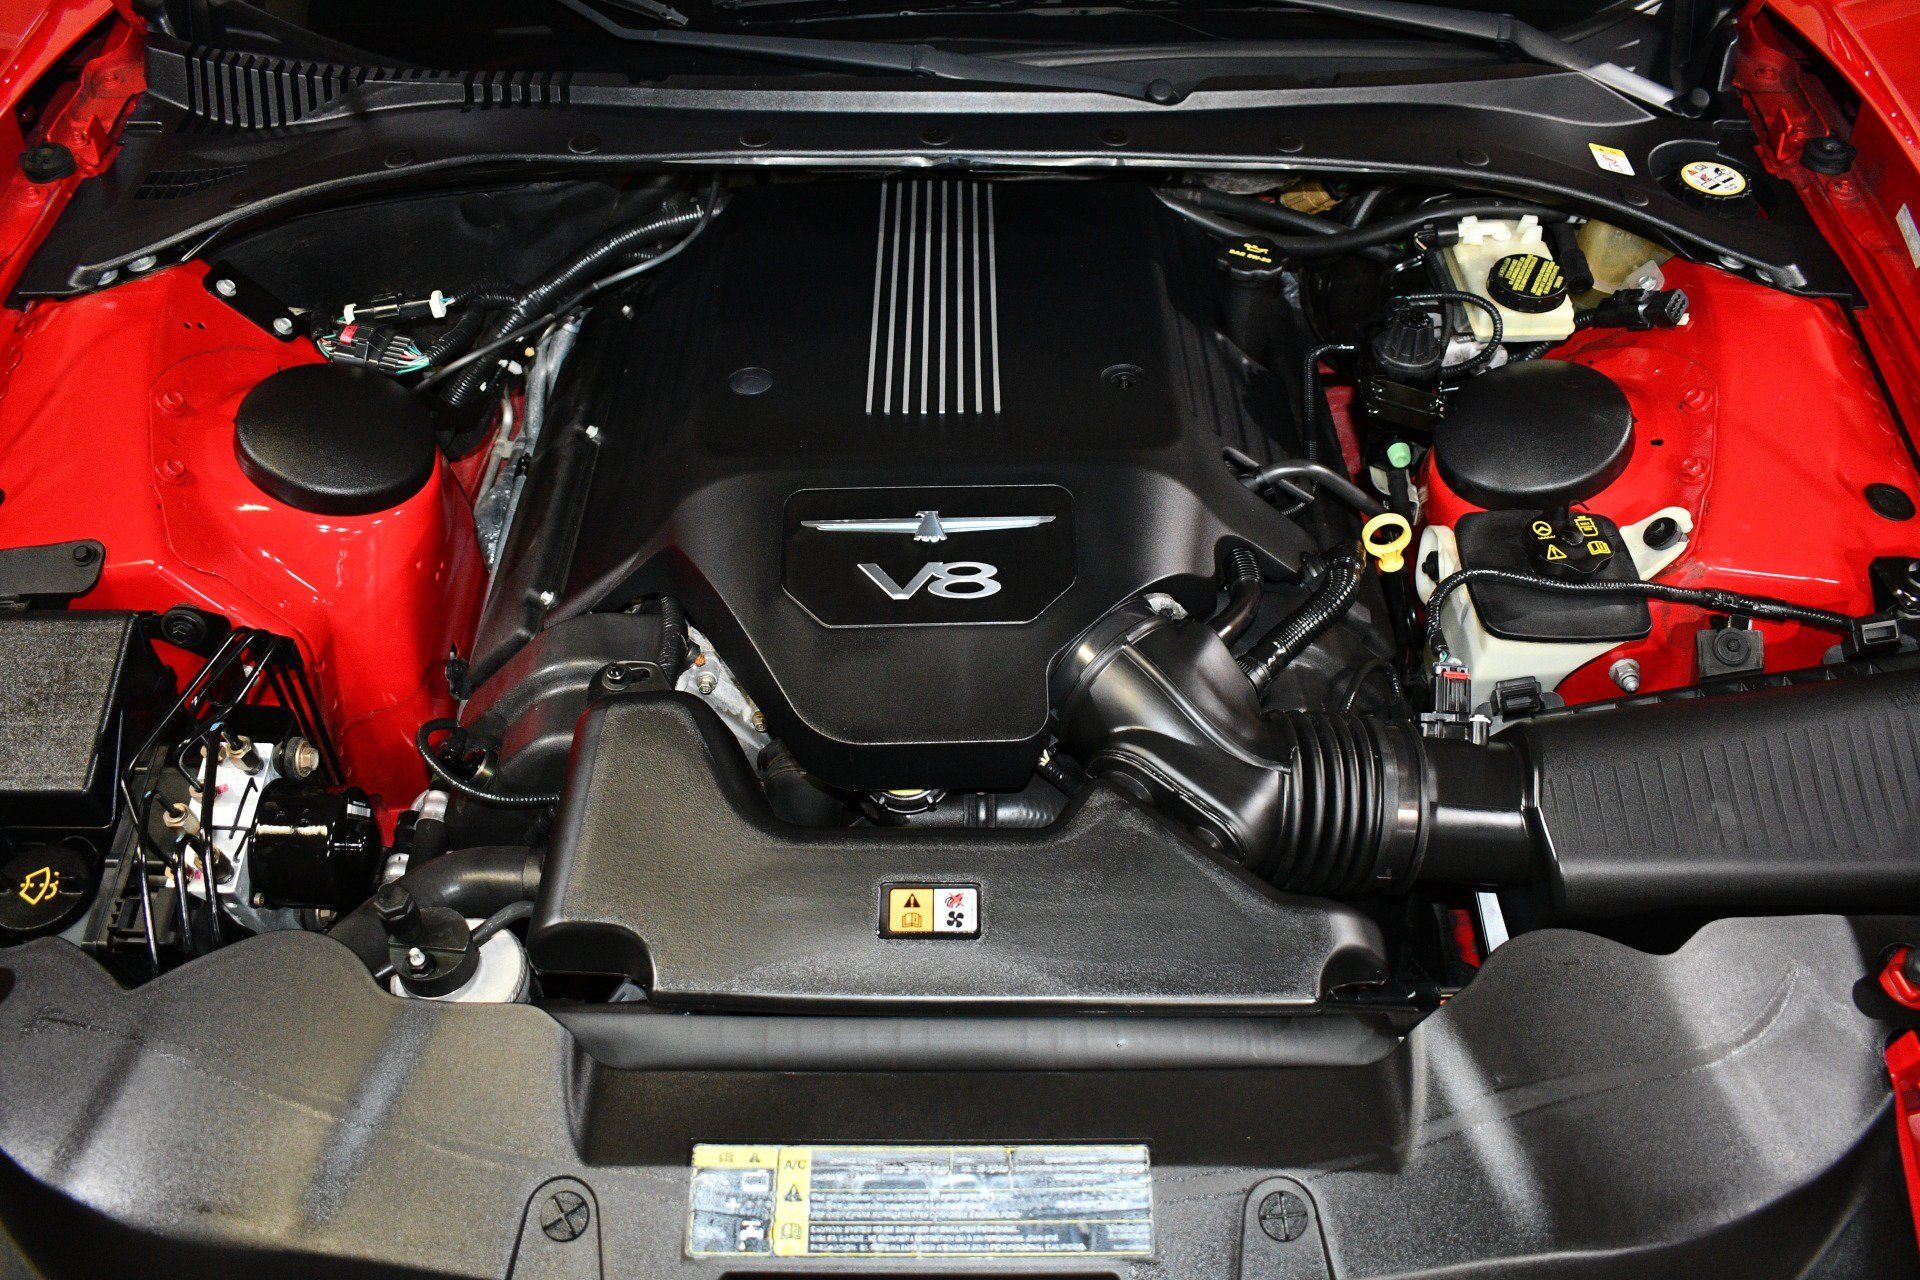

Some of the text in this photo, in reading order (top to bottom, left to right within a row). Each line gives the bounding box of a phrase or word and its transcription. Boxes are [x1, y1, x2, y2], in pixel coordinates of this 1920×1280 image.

[1229, 249, 1272, 263] SAE 5W-20
[857, 561, 1002, 600] V8
[784, 1159, 807, 1170] A/C
